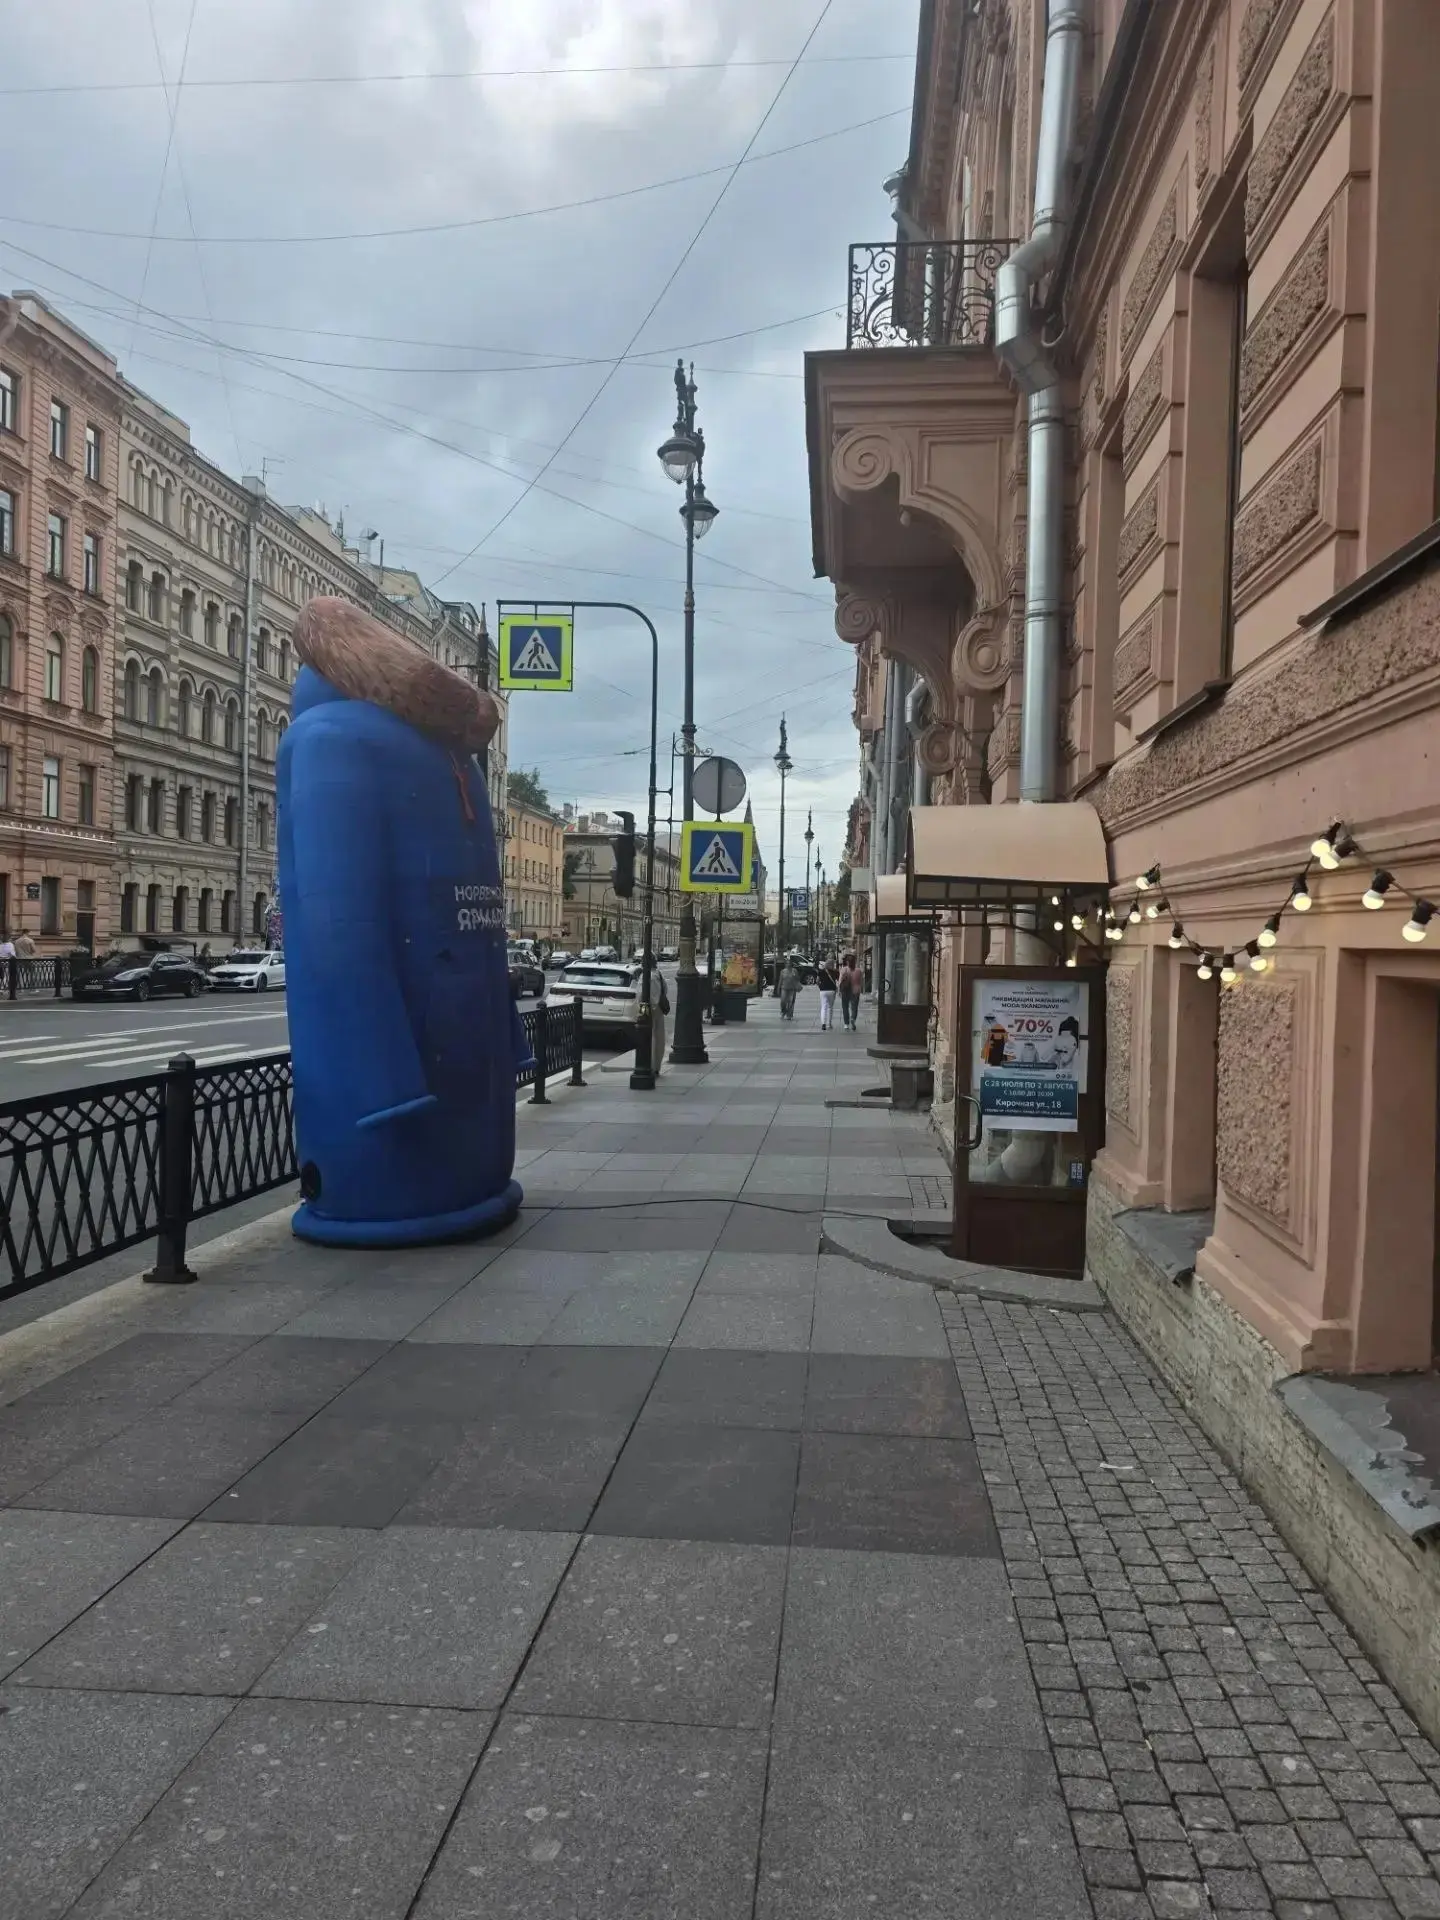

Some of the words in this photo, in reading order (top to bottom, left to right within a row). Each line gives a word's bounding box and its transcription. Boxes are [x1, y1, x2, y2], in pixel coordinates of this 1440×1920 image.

[1008, 1019, 1054, 1033] -70%
[1025, 1081, 1036, 1089] ПО
[1043, 1082, 1074, 1090] АВГУСТА
[995, 1098, 1035, 1108] Кирочная
[1051, 1100, 1062, 1108] 18
